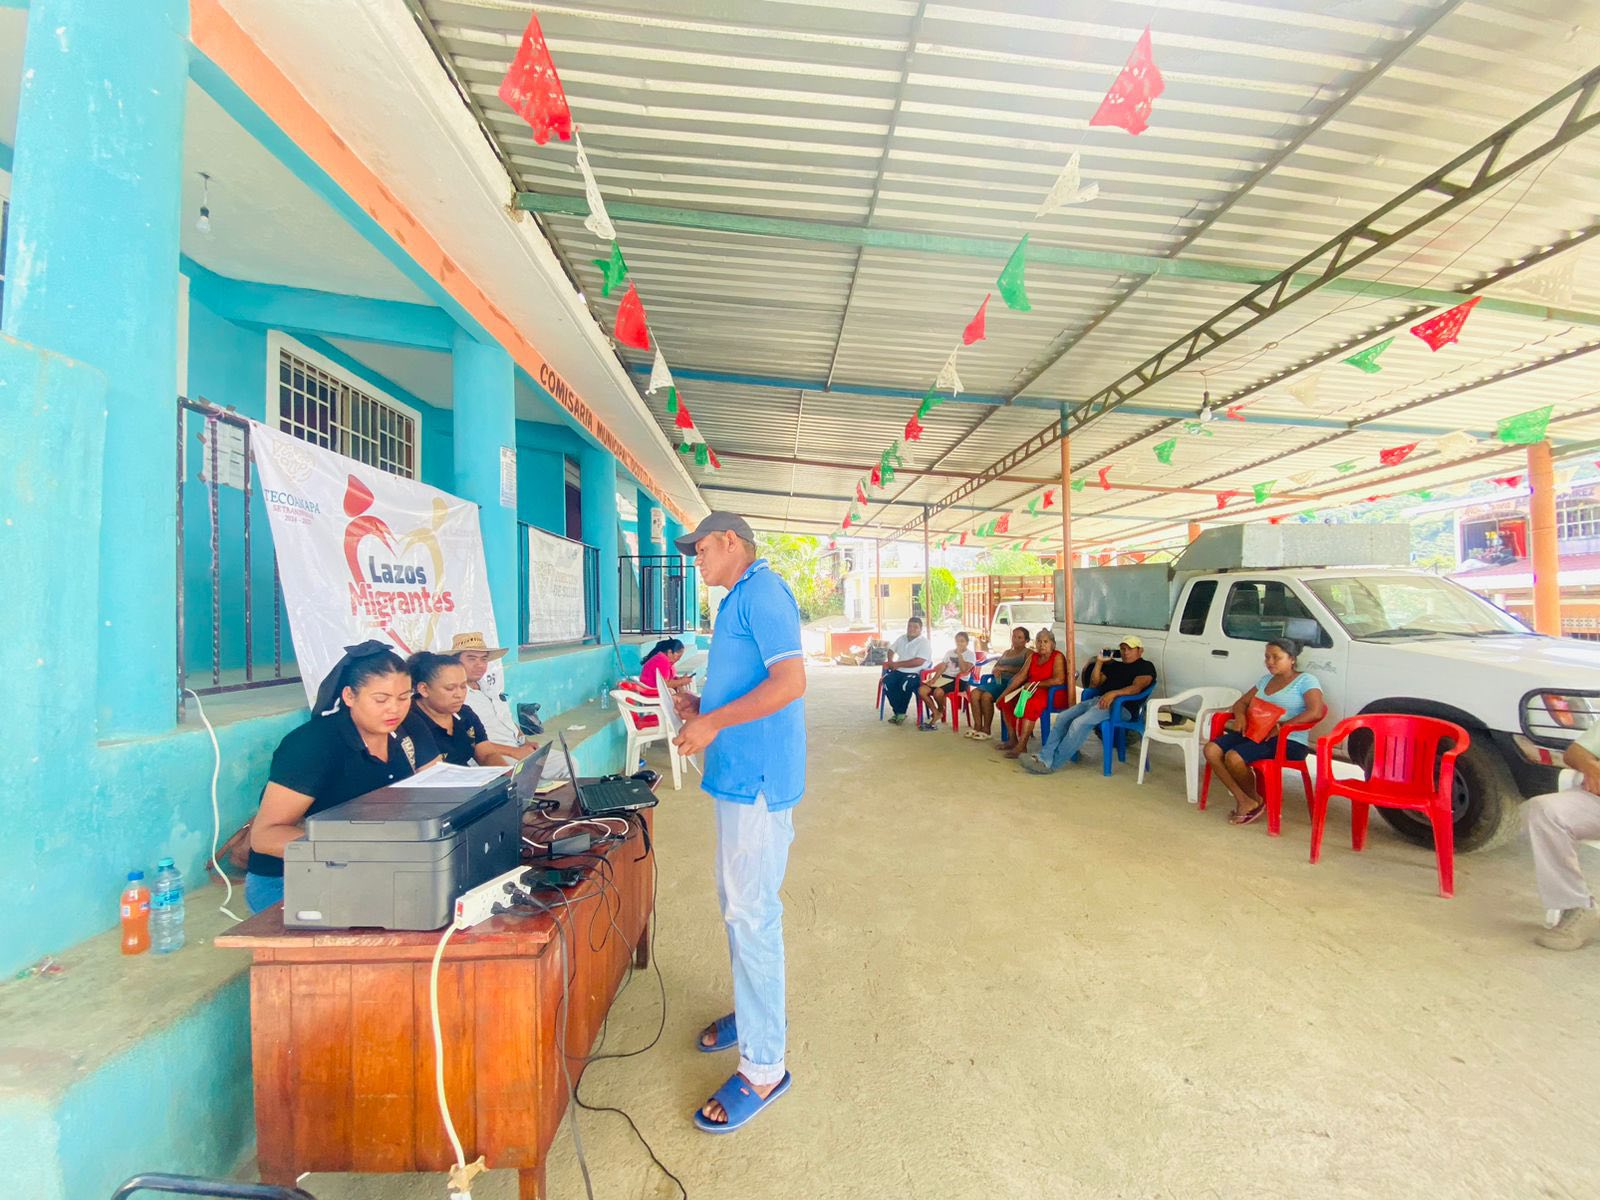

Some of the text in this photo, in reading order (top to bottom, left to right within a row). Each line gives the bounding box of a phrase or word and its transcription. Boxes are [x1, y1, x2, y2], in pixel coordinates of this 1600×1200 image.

[540, 363, 593, 432] COMISARIA
[369, 556, 427, 584] Lazos
[348, 582, 455, 623] Migrantes
